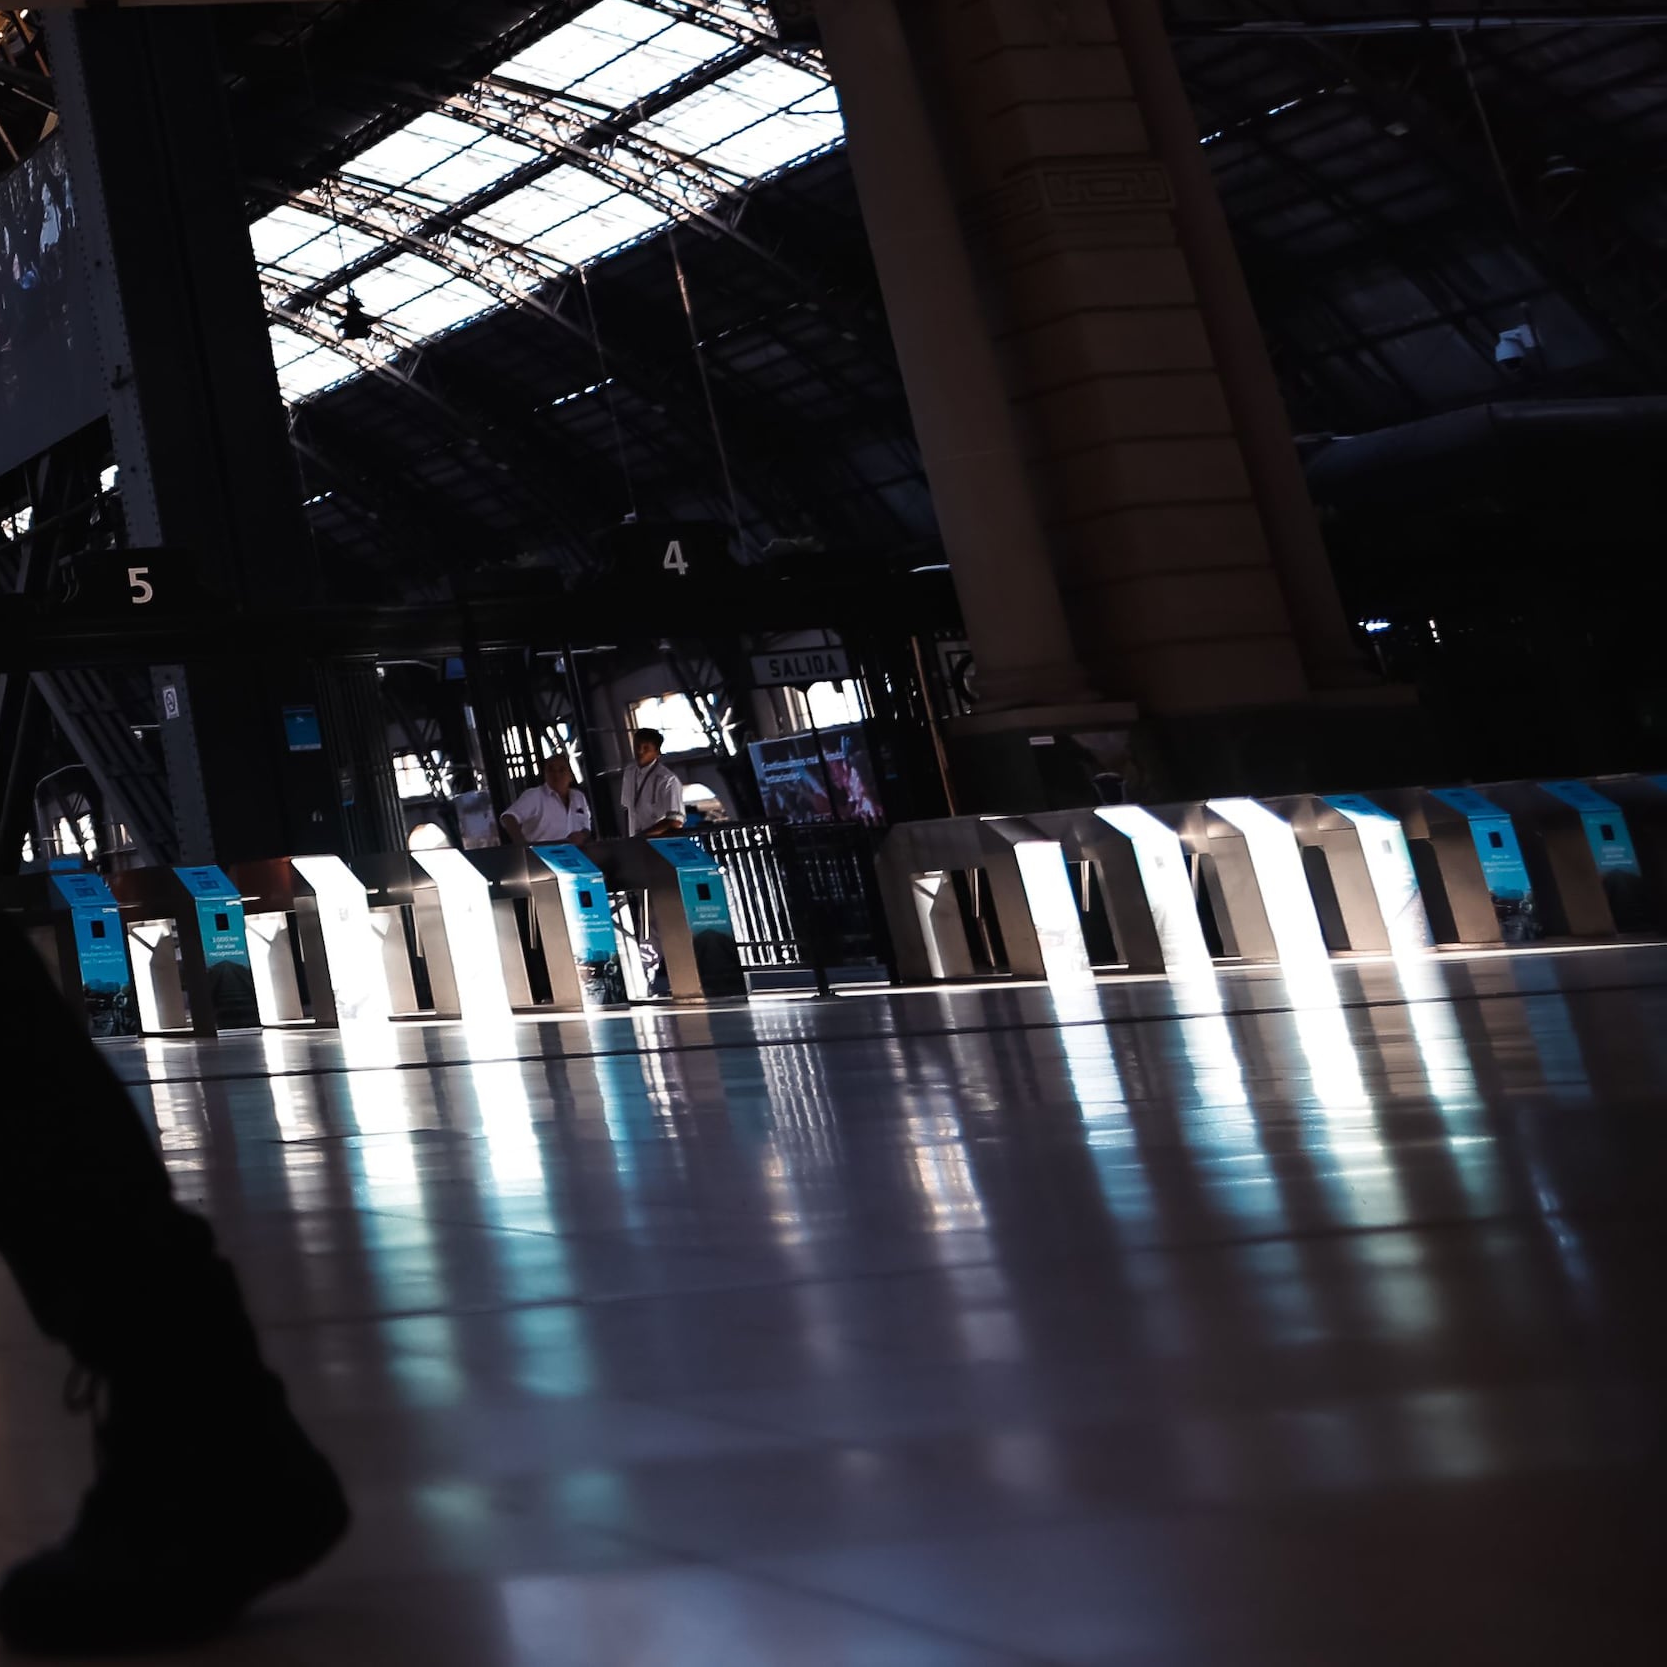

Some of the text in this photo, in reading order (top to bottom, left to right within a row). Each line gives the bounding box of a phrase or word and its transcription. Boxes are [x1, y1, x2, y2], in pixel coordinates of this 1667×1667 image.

[663, 540, 688, 575] 4
[127, 567, 153, 603] 5
[769, 653, 839, 679] SALIDA
